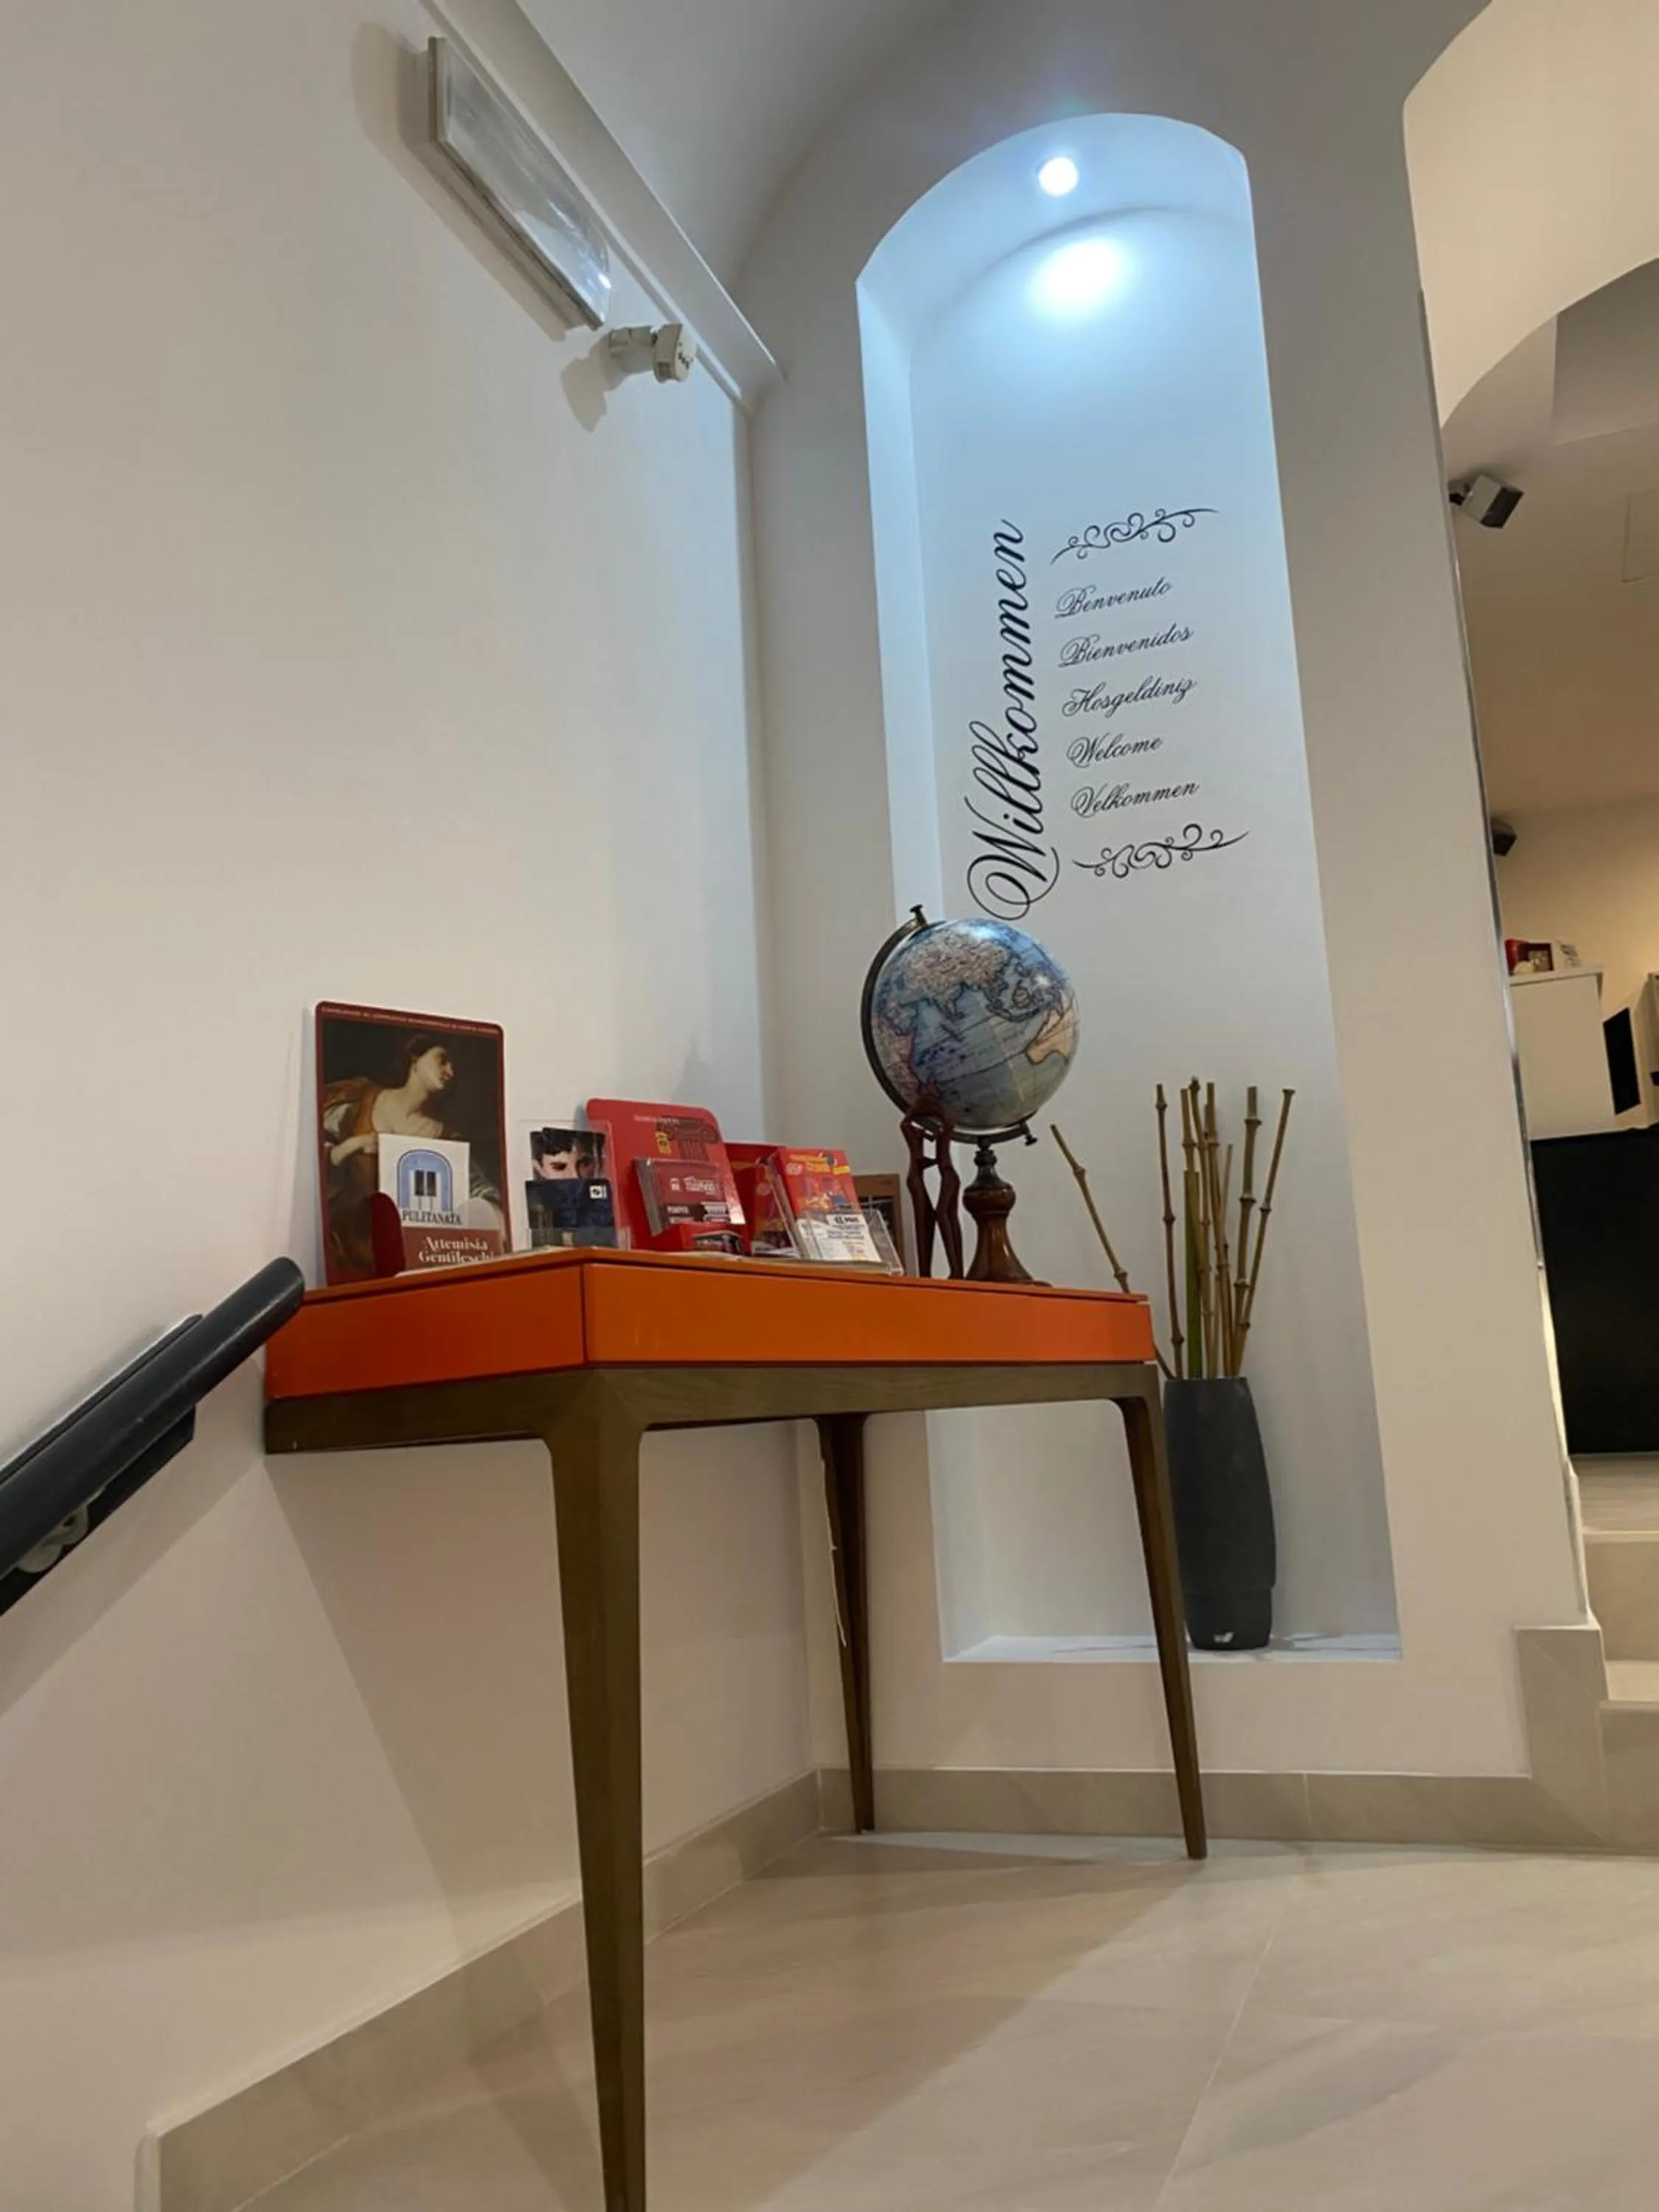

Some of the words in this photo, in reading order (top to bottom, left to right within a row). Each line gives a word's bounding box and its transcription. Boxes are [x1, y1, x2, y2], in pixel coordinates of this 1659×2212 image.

[1054, 576, 1173, 619] Benvenuto
[1057, 622, 1194, 668] Bienvenidos
[964, 519, 1060, 920] Willkommen
[1066, 732, 1164, 768] Welcome
[1071, 782, 1200, 818] Velkommen
[401, 1209, 462, 1225] PULITANATA
[422, 1236, 489, 1251] Artemisia
